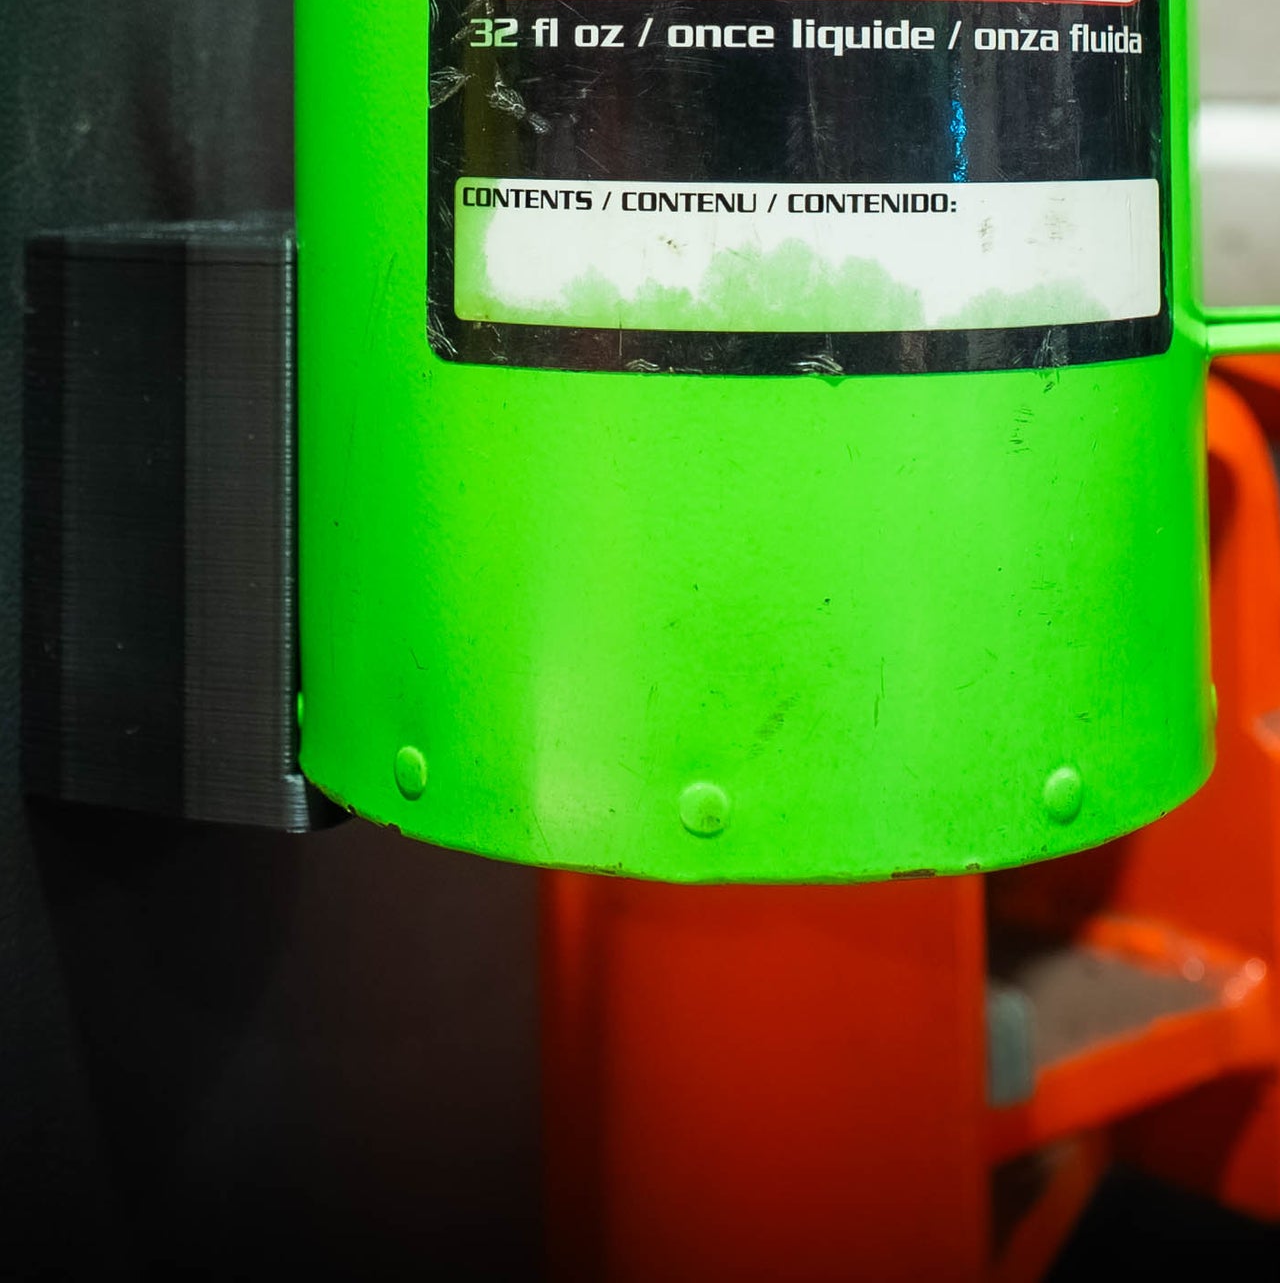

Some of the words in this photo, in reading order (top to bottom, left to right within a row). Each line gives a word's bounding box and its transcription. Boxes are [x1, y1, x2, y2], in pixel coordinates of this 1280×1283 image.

[470, 17, 519, 48] 32
[532, 17, 559, 48] fl
[575, 24, 625, 48] oz
[638, 17, 654, 48] /
[668, 24, 775, 49] once
[792, 18, 936, 57] liquide
[948, 20, 962, 51] /
[974, 27, 1060, 52] onza
[1070, 23, 1143, 55] fluida
[462, 186, 593, 211] CONTENTS
[602, 191, 613, 212] /
[621, 191, 757, 214] CONTENU
[767, 193, 778, 214] /
[787, 192, 958, 215] CONTENIDO:
